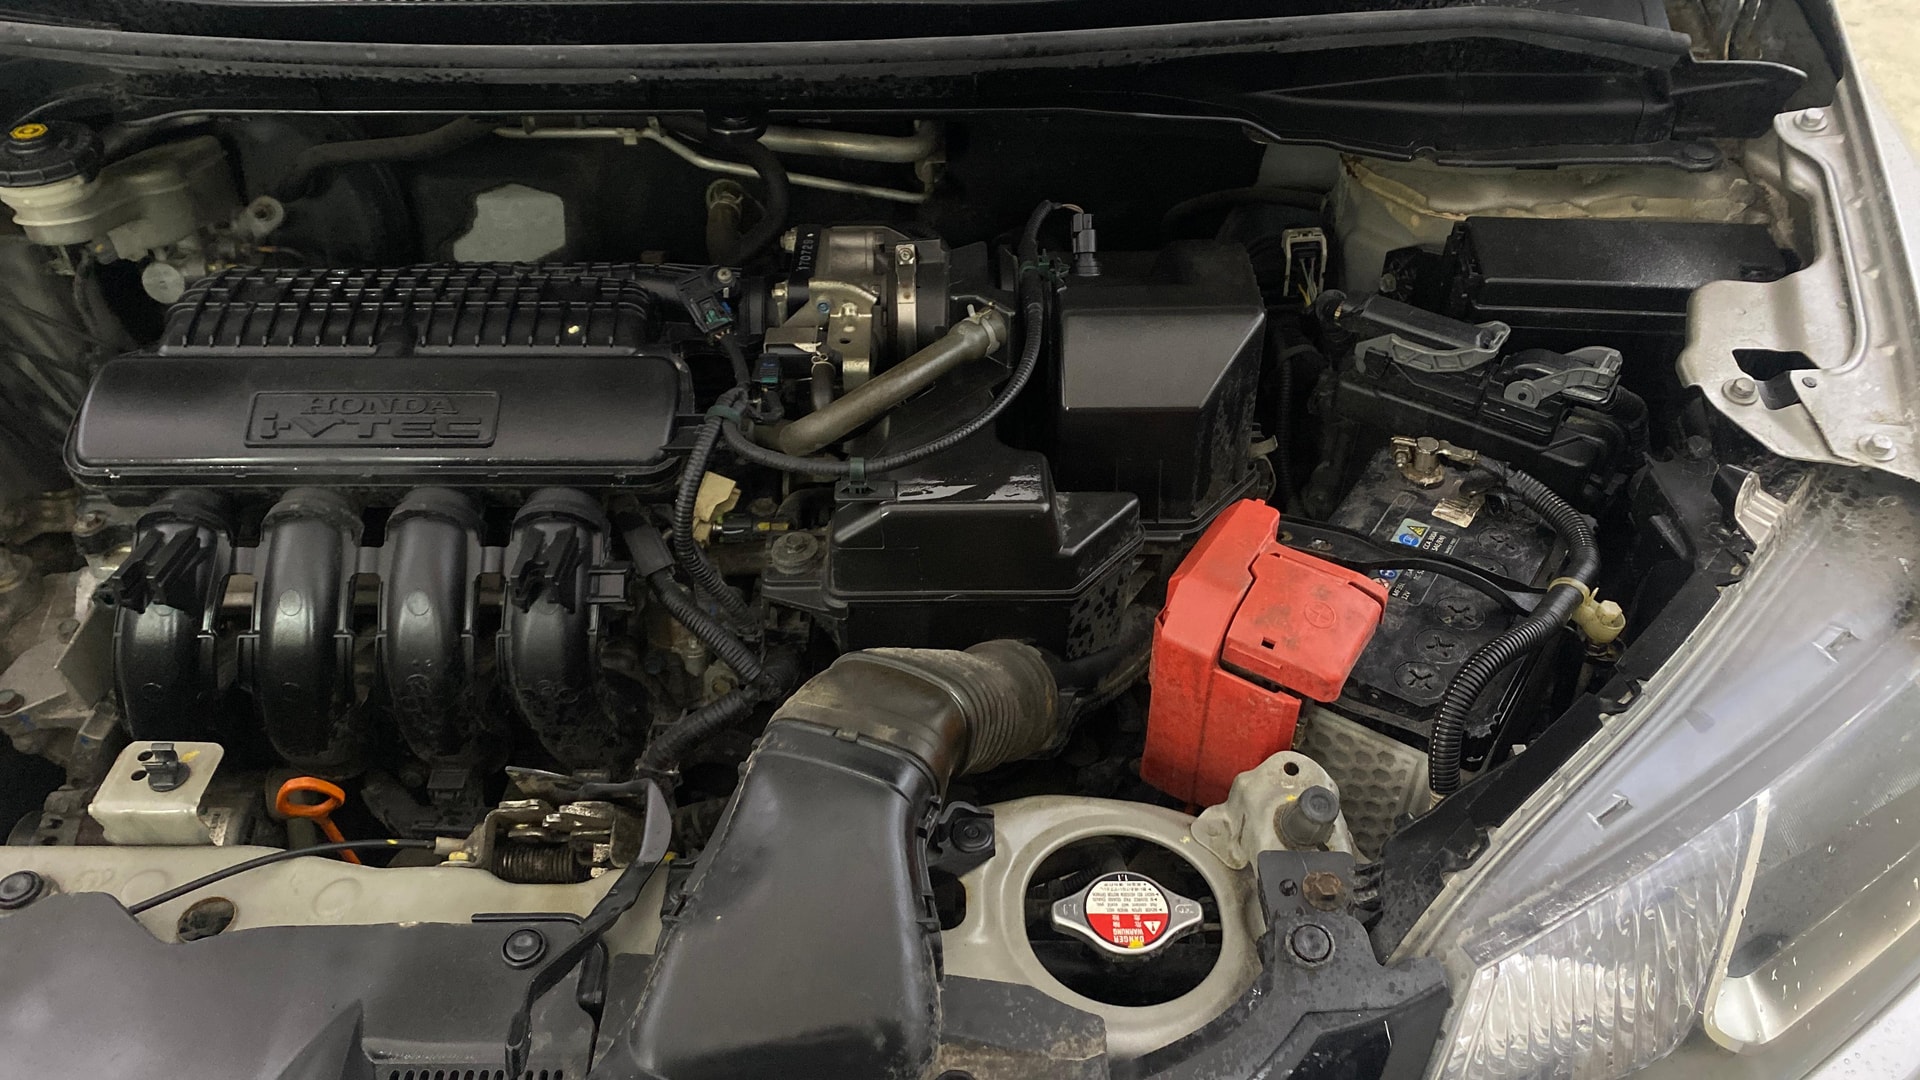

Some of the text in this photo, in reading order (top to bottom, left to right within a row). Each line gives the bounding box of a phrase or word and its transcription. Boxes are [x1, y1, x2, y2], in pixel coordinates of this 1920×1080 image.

[299, 396, 459, 416] HONDA
[259, 412, 482, 439] i-VTEC
[1112, 928, 1144, 936] WARNUNG
